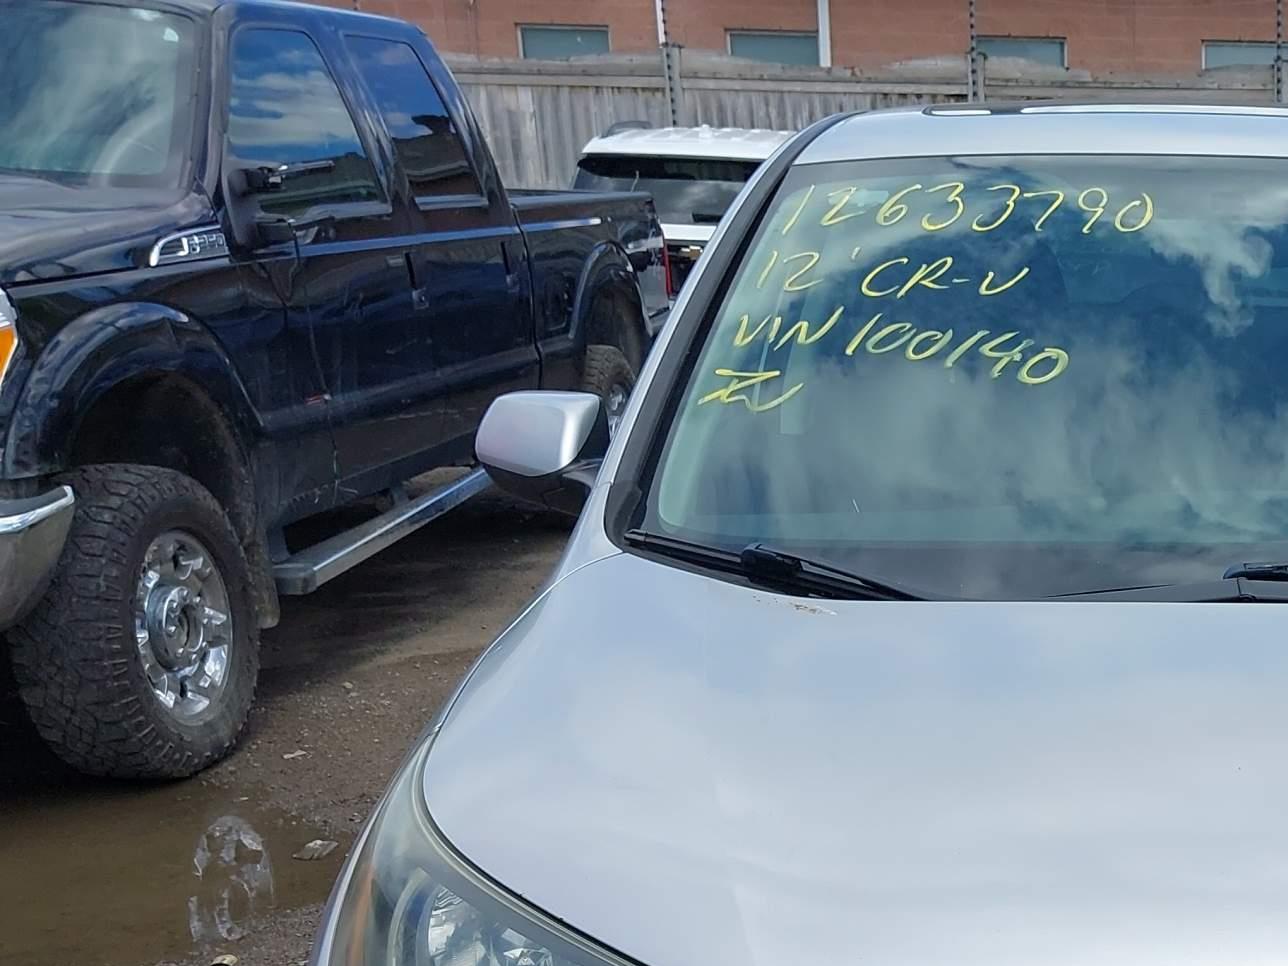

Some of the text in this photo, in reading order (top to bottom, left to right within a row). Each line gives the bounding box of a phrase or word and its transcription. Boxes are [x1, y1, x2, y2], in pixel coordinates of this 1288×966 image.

[782, 182, 1154, 234] 12633790
[733, 305, 1070, 386] VIN 100140
